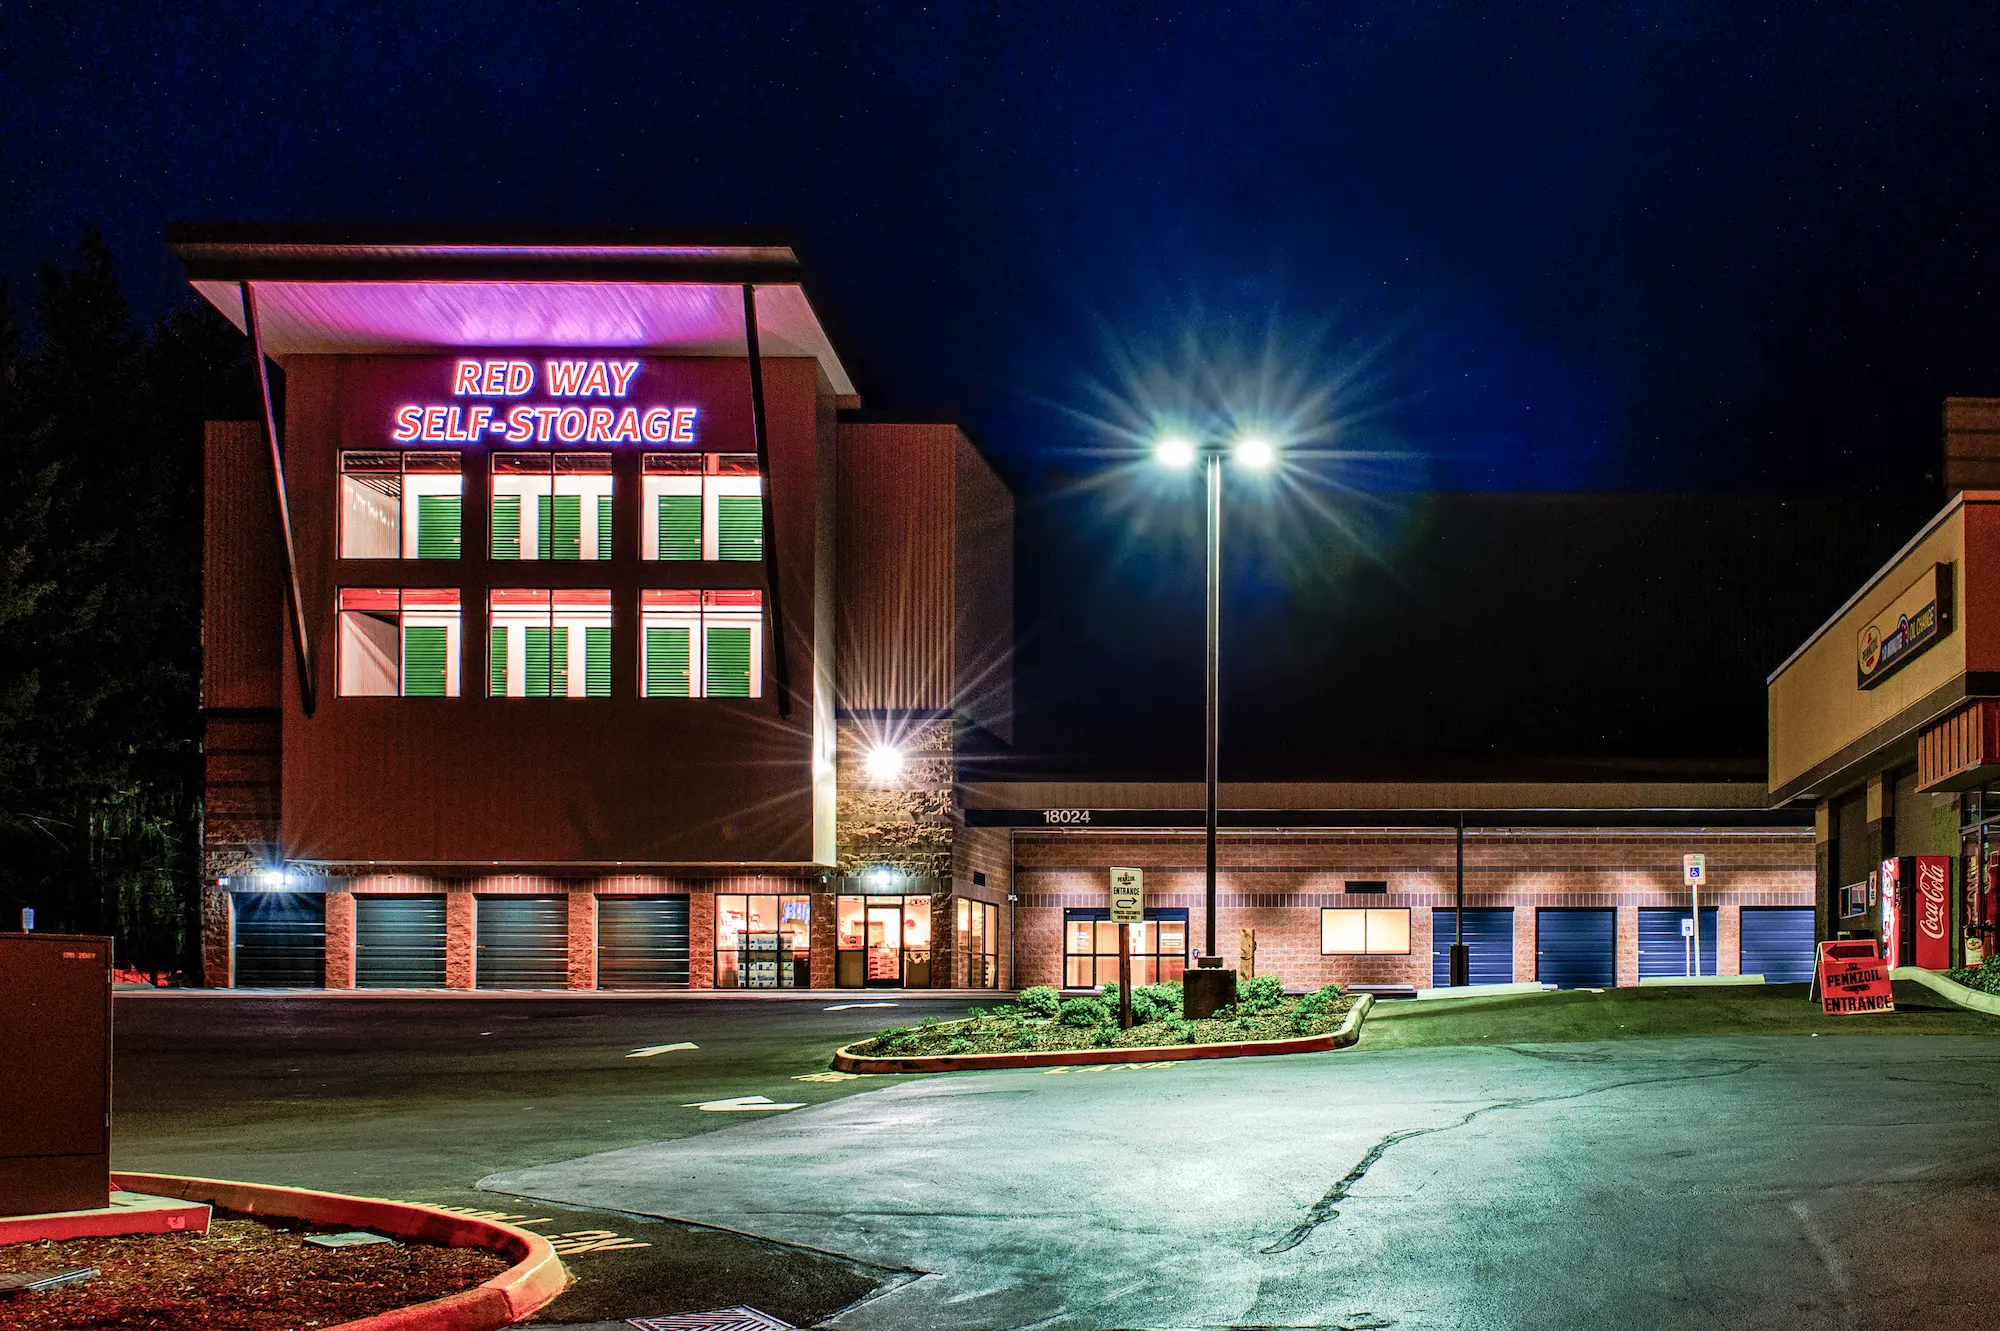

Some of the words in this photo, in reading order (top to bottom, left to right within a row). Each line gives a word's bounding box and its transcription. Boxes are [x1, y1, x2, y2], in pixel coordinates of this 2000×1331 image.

[454, 360, 534, 396] RED
[547, 360, 639, 397] WAY
[393, 405, 698, 443] SELF-STORAGE
[1043, 810, 1091, 824] 18024
[1113, 887, 1140, 895] ENTRANCE
[1826, 969, 1882, 988] PENNZOIL
[1824, 995, 1892, 1013] ENTRANCE
